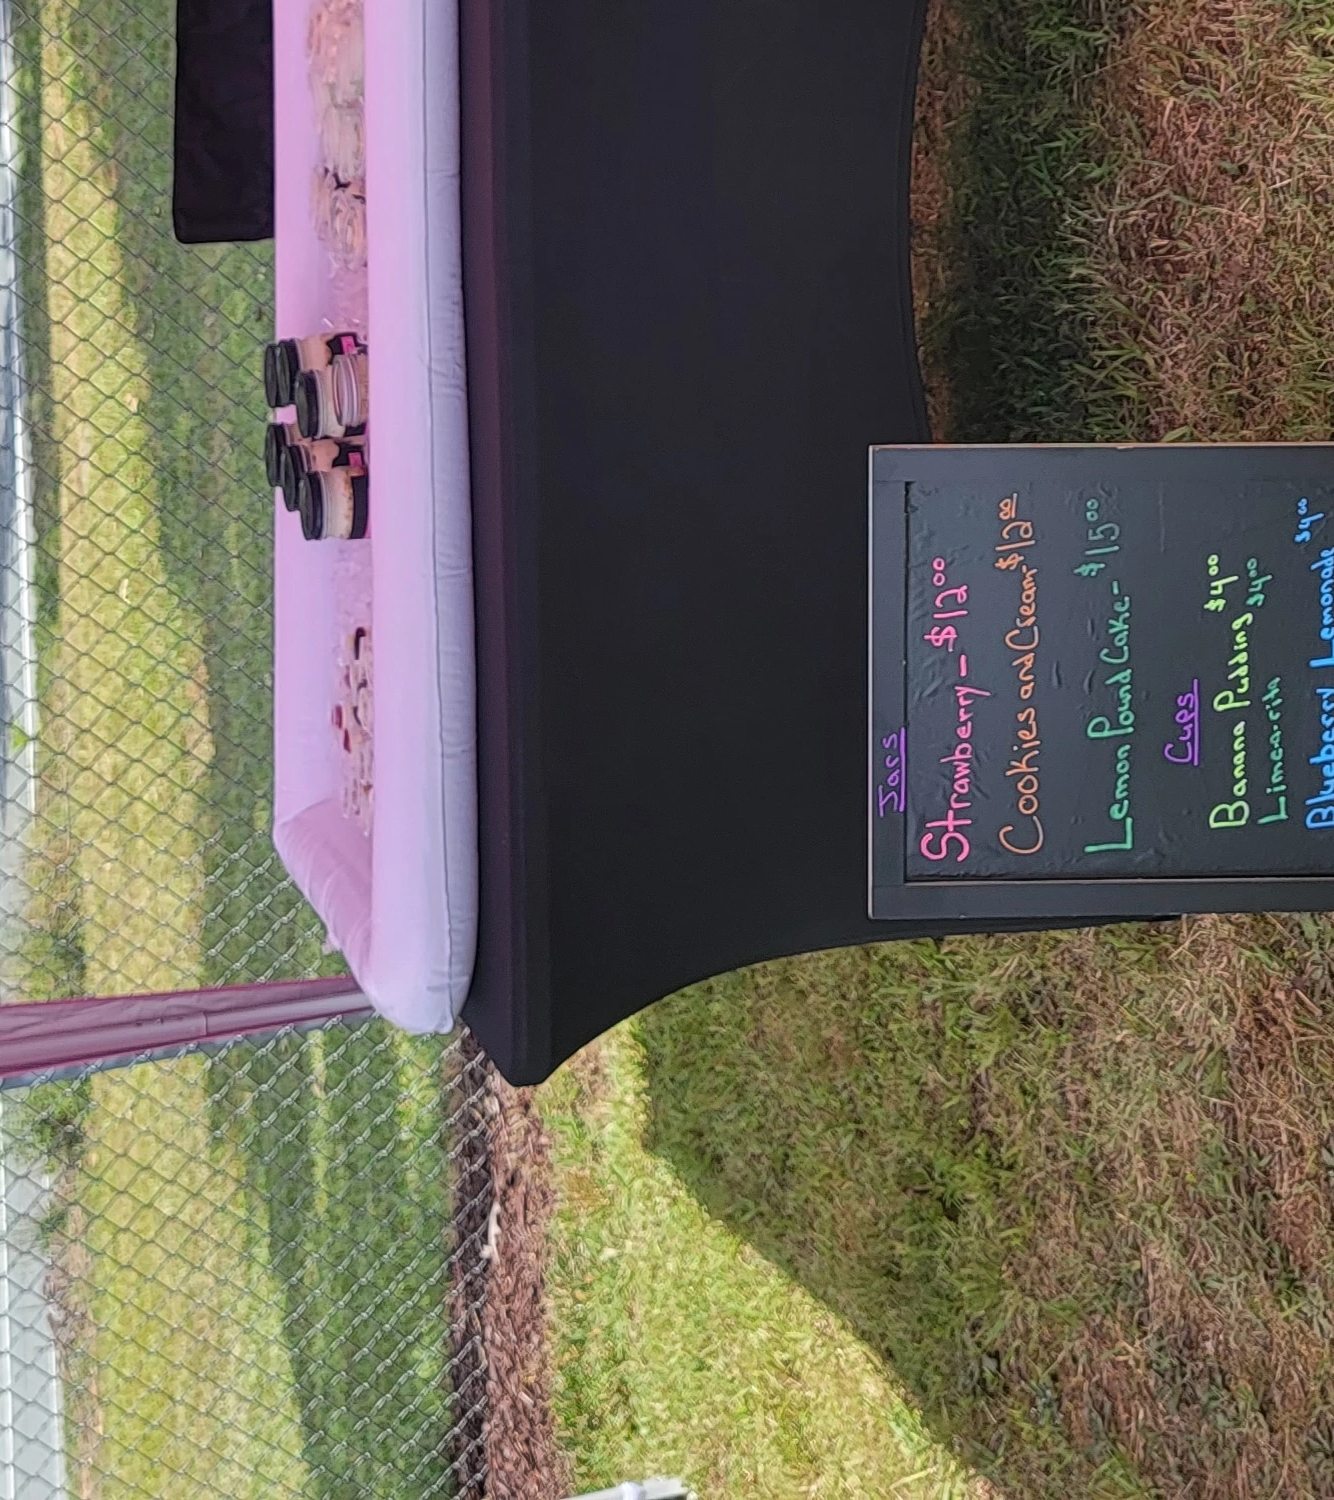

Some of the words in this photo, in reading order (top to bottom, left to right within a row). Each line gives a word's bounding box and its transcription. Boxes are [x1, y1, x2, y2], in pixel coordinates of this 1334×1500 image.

[1016, 653, 1037, 700] and
[1085, 669, 1135, 739] Pound
[1213, 612, 1253, 711] Pudding
[877, 732, 900, 817] Jars
[920, 684, 990, 861] Strawberry
[1164, 691, 1195, 765] Cups
[1209, 721, 1251, 828] Banana
[998, 707, 1043, 854] Cookies
[1084, 744, 1134, 853] Lemon
